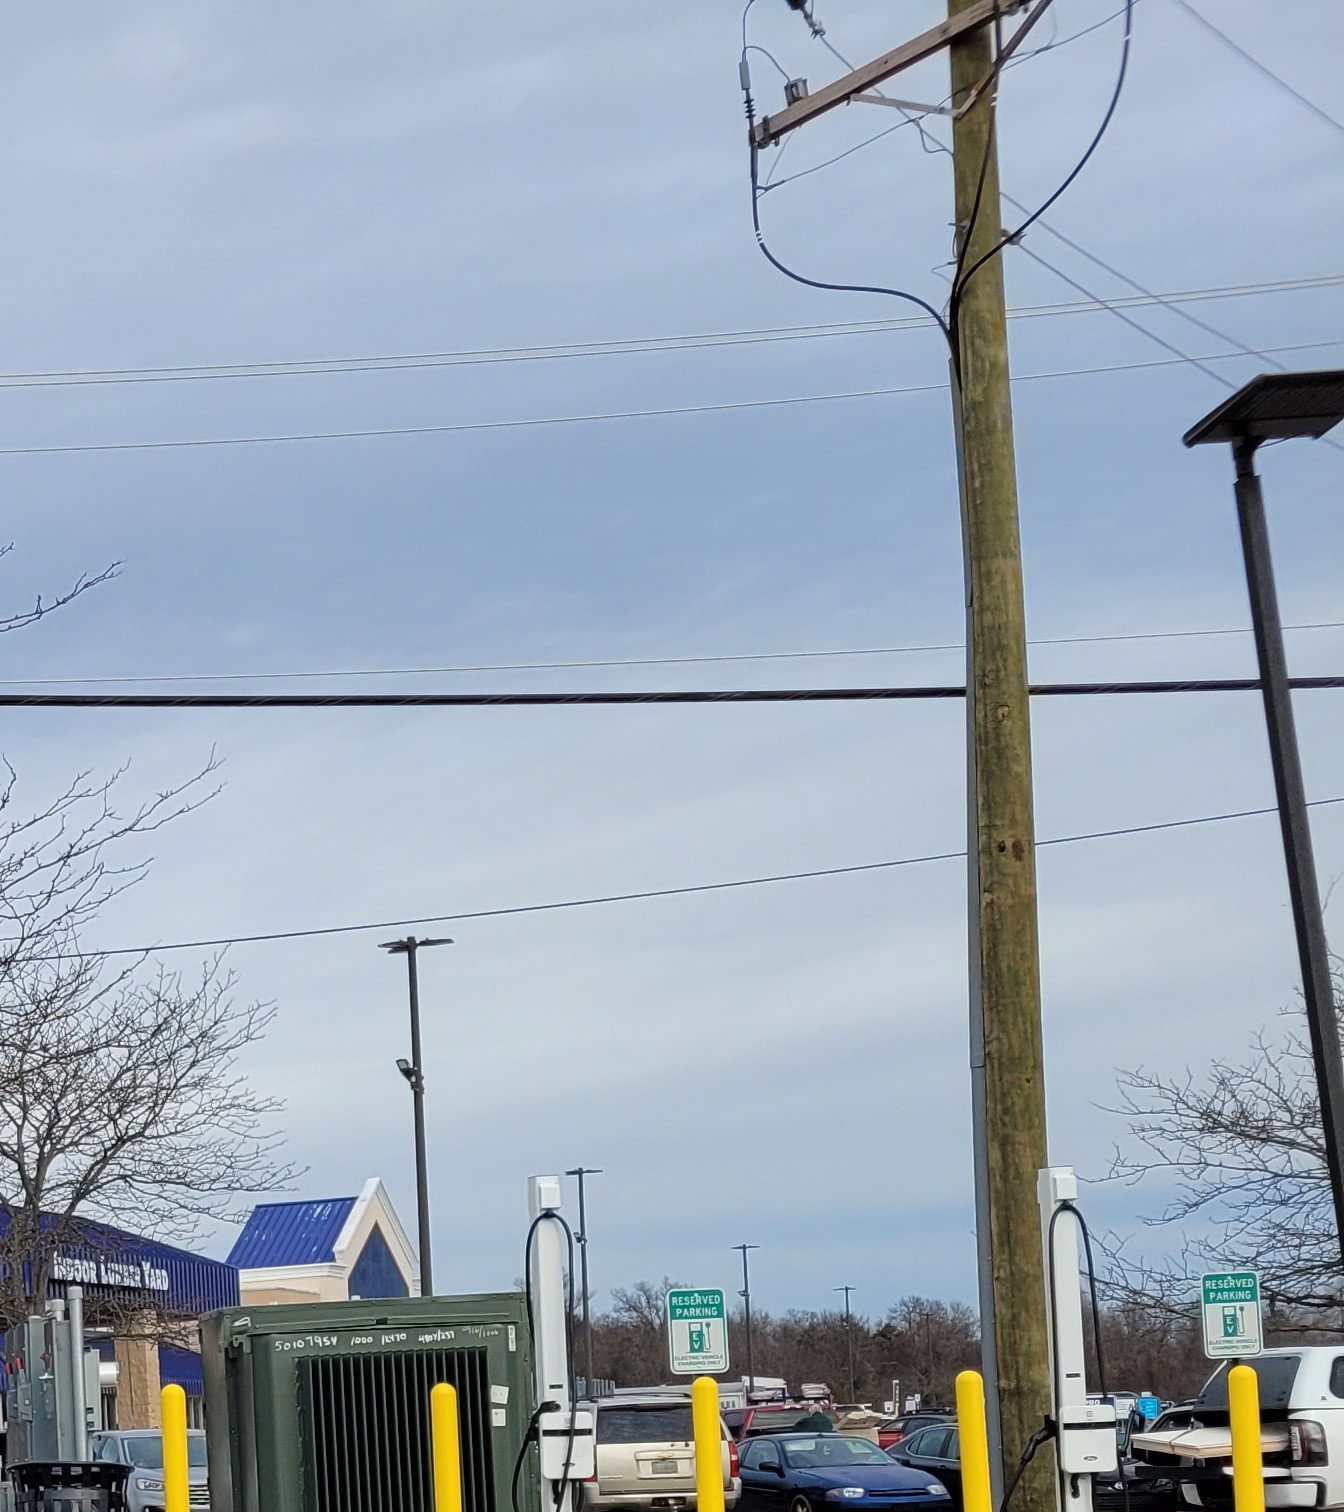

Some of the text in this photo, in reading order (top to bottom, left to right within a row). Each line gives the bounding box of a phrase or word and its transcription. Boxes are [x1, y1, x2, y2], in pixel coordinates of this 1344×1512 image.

[141, 1261, 169, 1291] YARD
[1205, 1278, 1254, 1289] RESERVED
[672, 1294, 721, 1306] RESERVED
[1209, 1290, 1251, 1301] PARKING
[676, 1306, 718, 1317] PARKING
